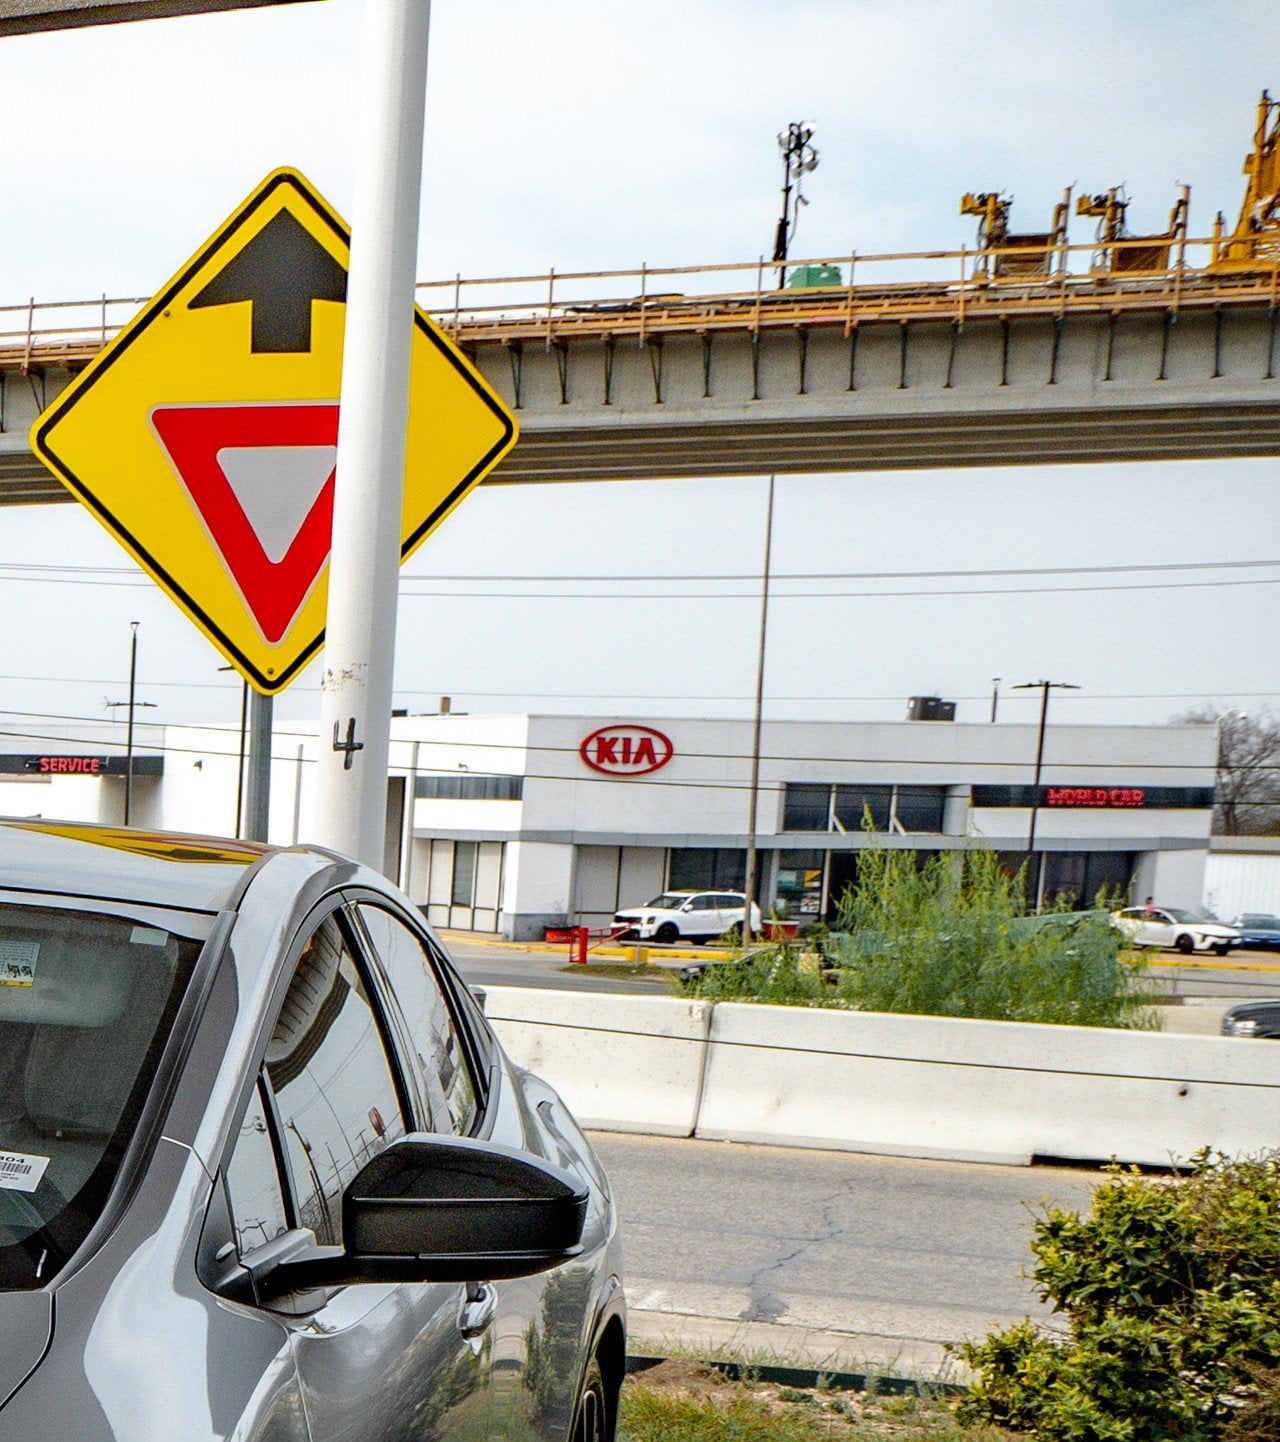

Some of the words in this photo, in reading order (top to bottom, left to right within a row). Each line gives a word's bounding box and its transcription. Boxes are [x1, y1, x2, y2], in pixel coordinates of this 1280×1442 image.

[332, 717, 364, 770] 4
[596, 736, 657, 765] KIA
[40, 757, 100, 772] SERVICE
[1048, 788, 1108, 805] WORLD
[1110, 789, 1144, 806] CAR
